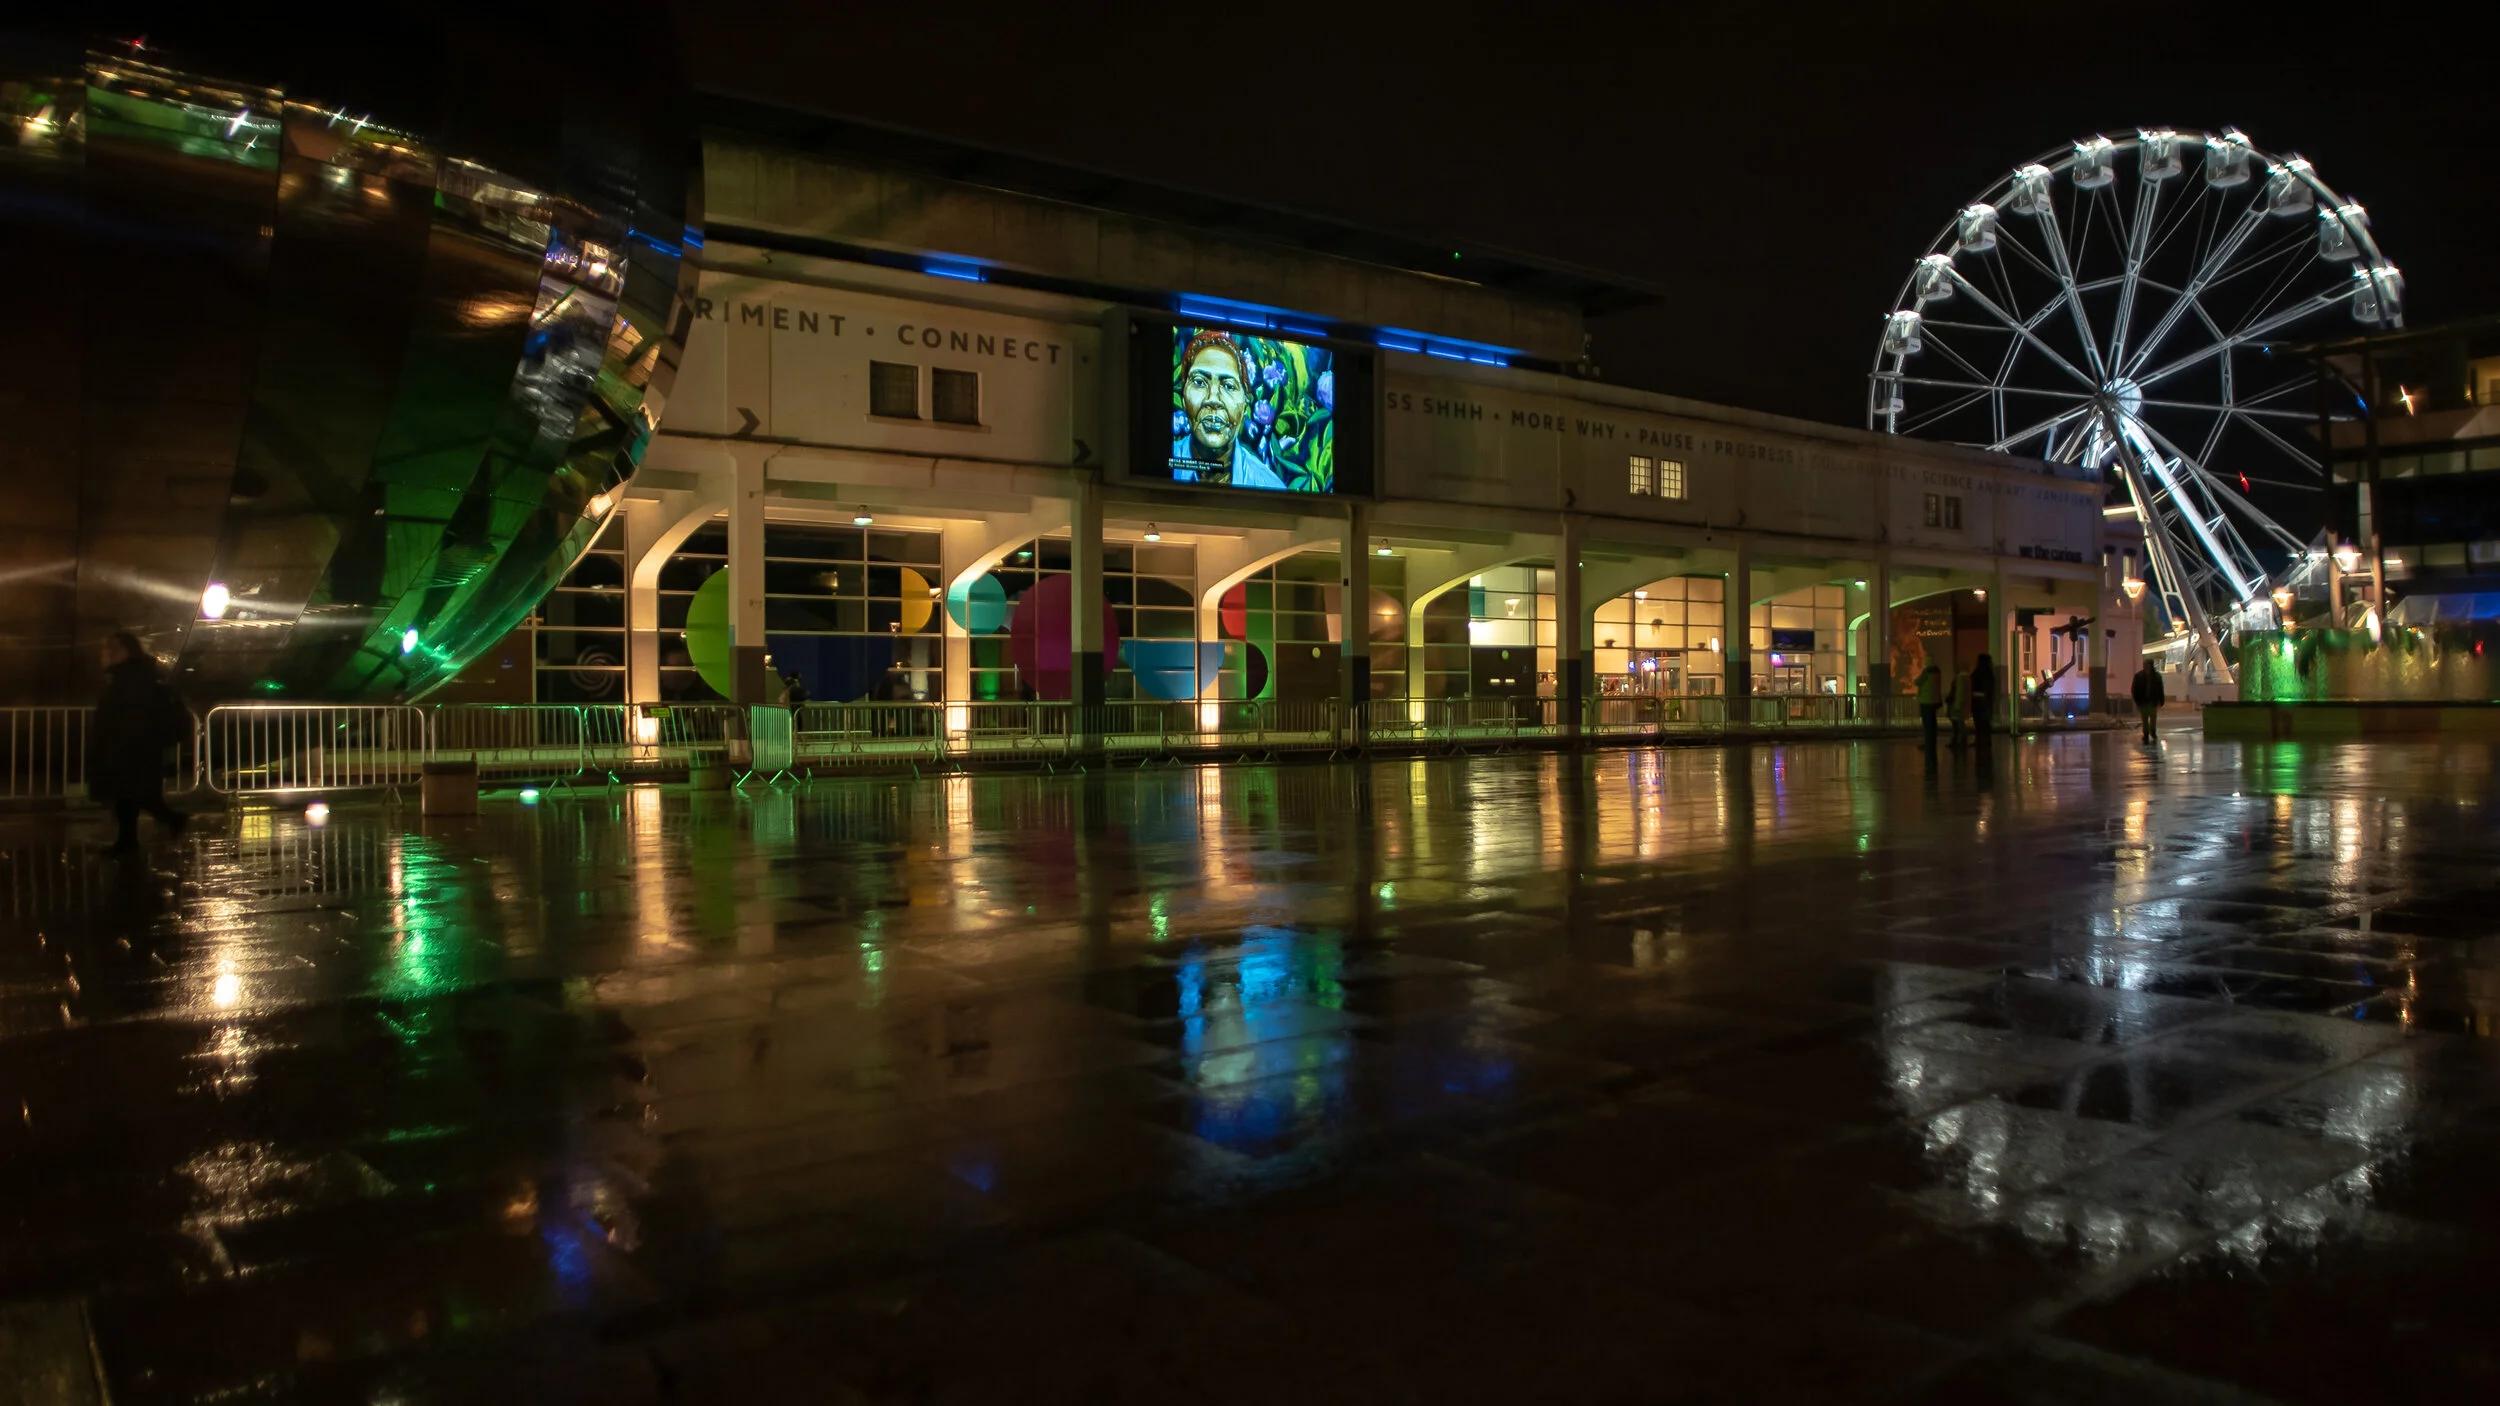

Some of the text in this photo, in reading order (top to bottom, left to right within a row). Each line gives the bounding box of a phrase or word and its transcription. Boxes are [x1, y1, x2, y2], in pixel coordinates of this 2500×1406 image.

[695, 297, 1061, 364] RIMENT CONNECT
[1387, 392, 1412, 411] SS
[1423, 397, 1482, 421] SHHH
[1511, 410, 1566, 432] MORE
[1576, 419, 1615, 439] WHY
[1639, 428, 1693, 450] PAUSE
[1715, 440, 1795, 464] PROGRESS
[1922, 471, 1973, 490] SCIENCE
